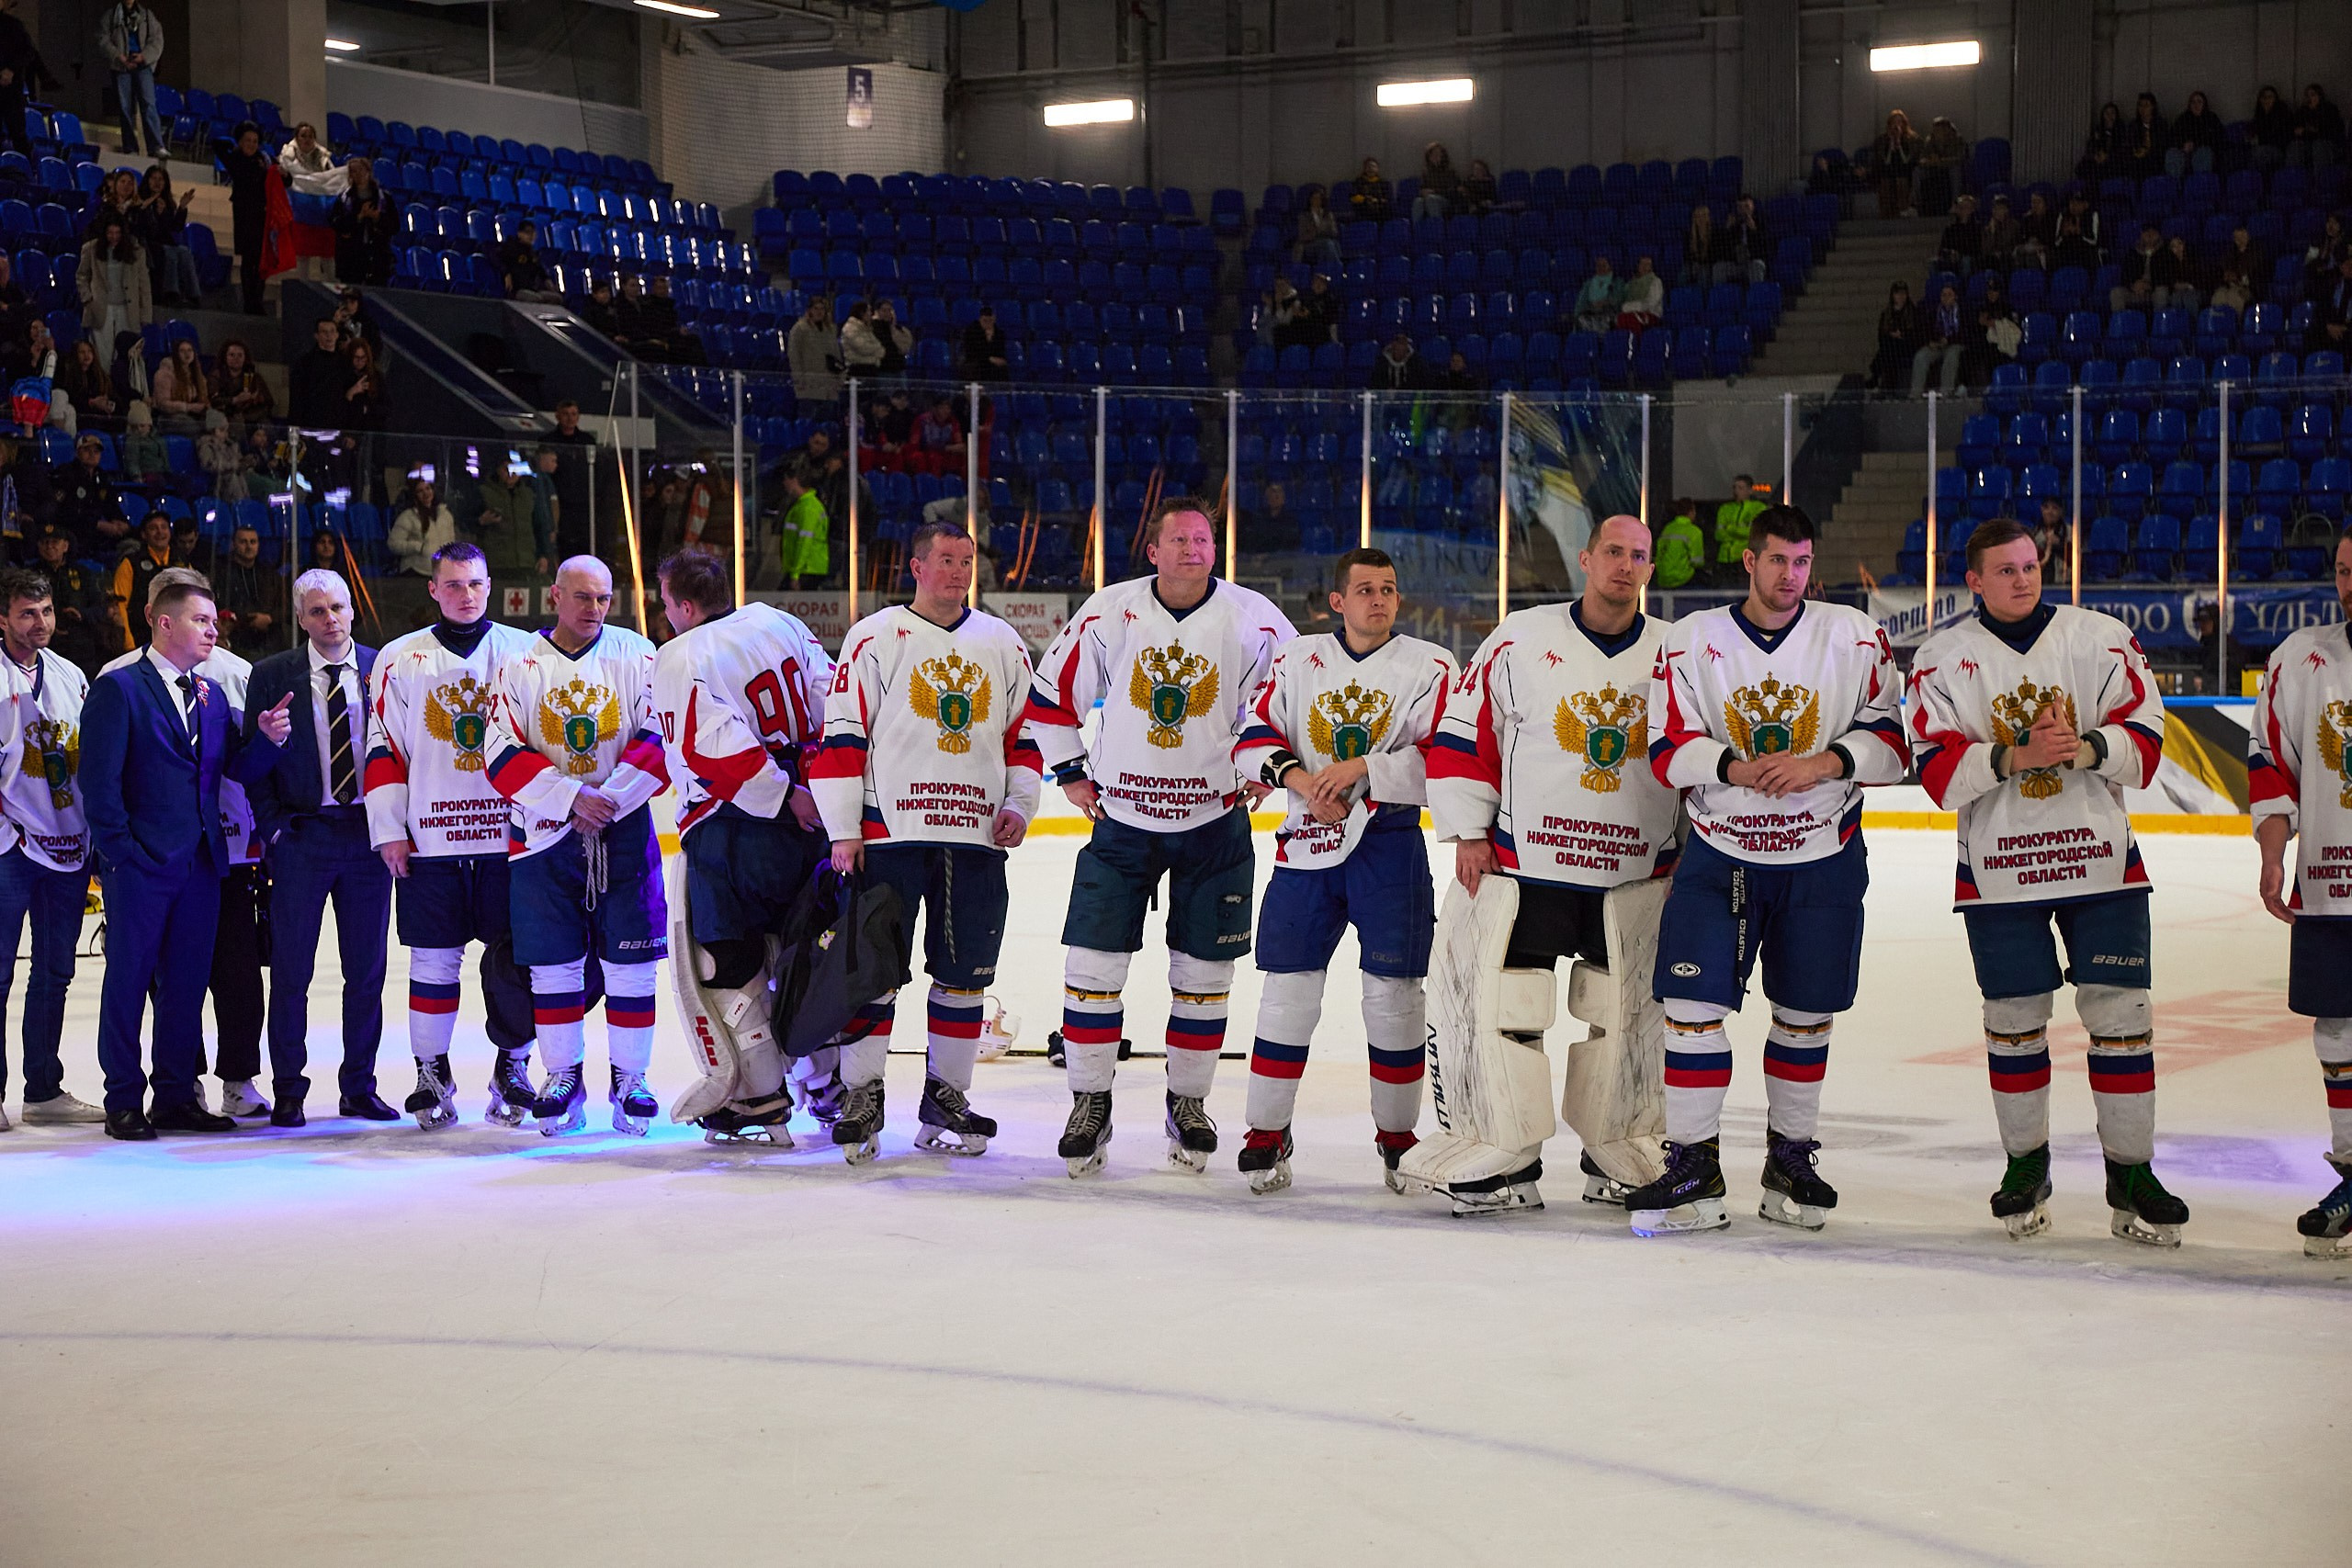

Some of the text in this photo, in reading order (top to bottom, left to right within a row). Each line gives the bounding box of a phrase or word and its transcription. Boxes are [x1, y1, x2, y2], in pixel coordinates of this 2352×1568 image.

[854, 75, 865, 103] 5
[1005, 602, 1046, 618] СКОРАЯ
[744, 656, 820, 751] 90
[1119, 772, 1208, 789] ПРОКУРАТУРА
[1135, 802, 1192, 820] ОБЛАСТИ
[924, 814, 979, 829] ОБЛАСТИ
[1543, 815, 1640, 840] ПРОКУРАТУРА
[446, 828, 502, 841] ОБЛАСТИ
[1526, 830, 1649, 857] НИЖЕГОРОДСКОЙ
[1555, 852, 1620, 872] ОБЛАСТИ
[1984, 840, 2113, 870] НИЖЕГОРОДСКОЙ
[2018, 864, 2086, 886] ОБЛАСТИ
[1676, 1179, 1700, 1195] CCM
